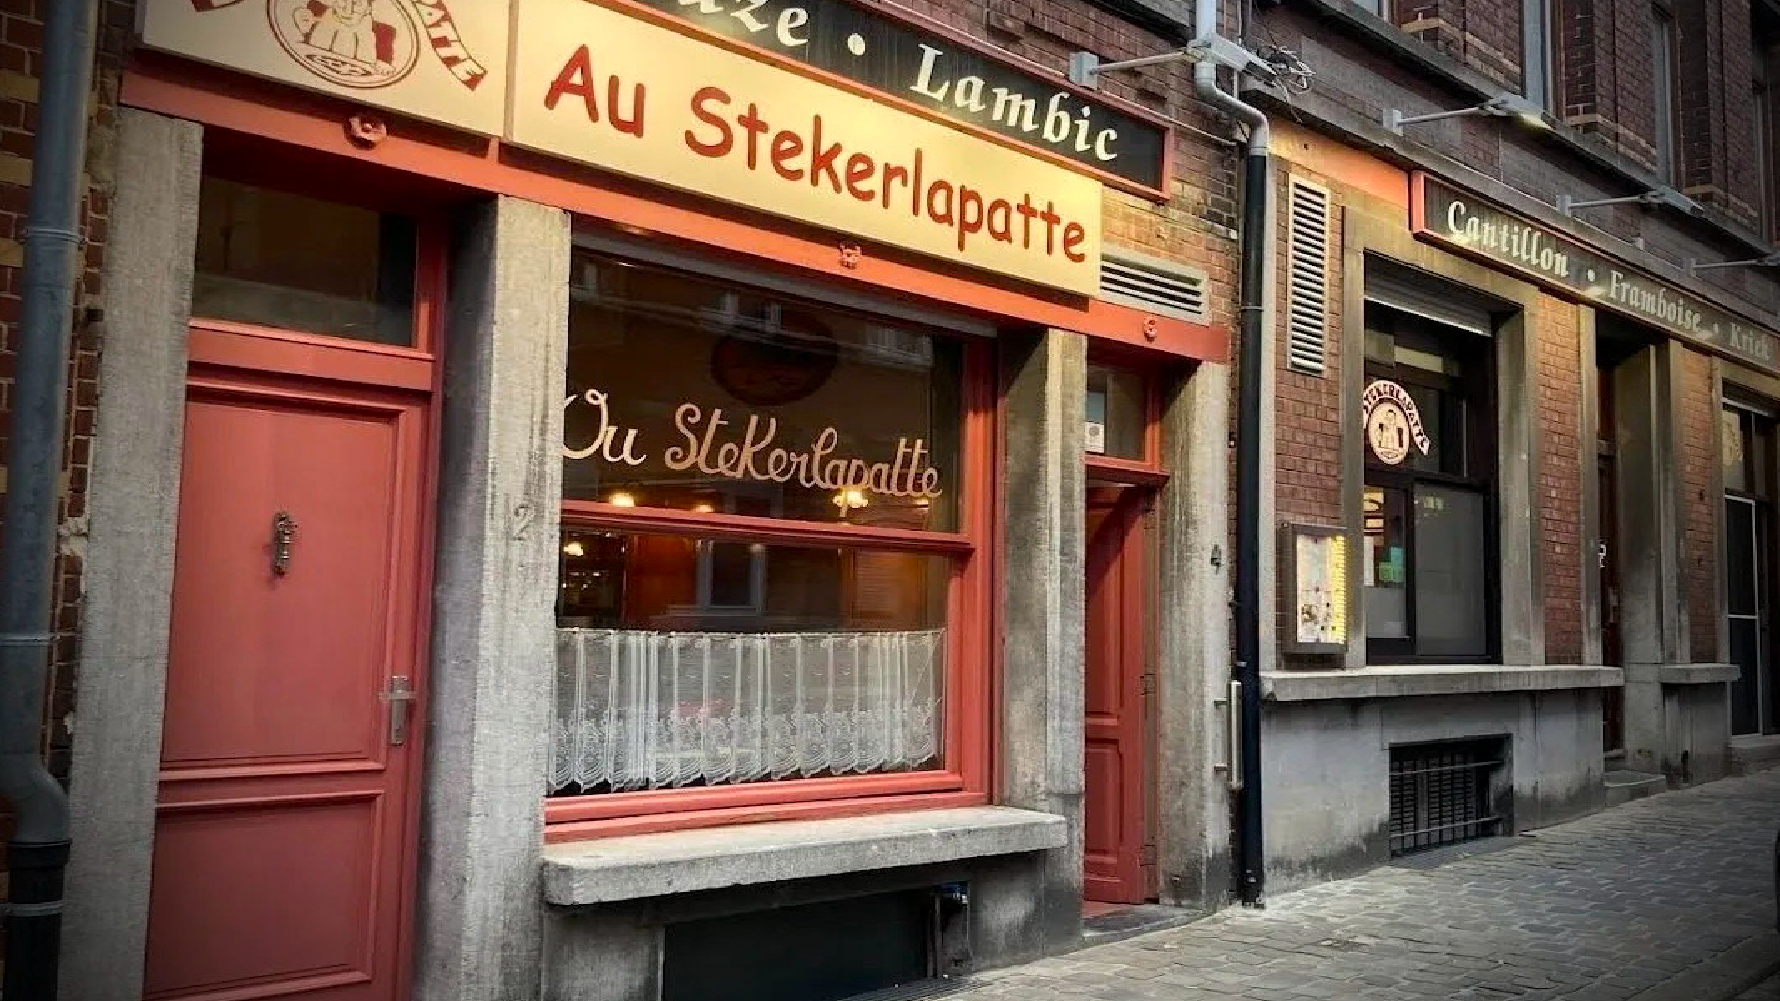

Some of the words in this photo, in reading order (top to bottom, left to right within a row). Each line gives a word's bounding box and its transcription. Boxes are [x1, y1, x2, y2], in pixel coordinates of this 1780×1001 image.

[543, 44, 647, 139] Au
[684, 86, 1088, 263] Stekerlapatte
[909, 43, 1119, 162] Lambic
[1447, 200, 1570, 278] Cantillon
[1609, 269, 1702, 333] Framboise
